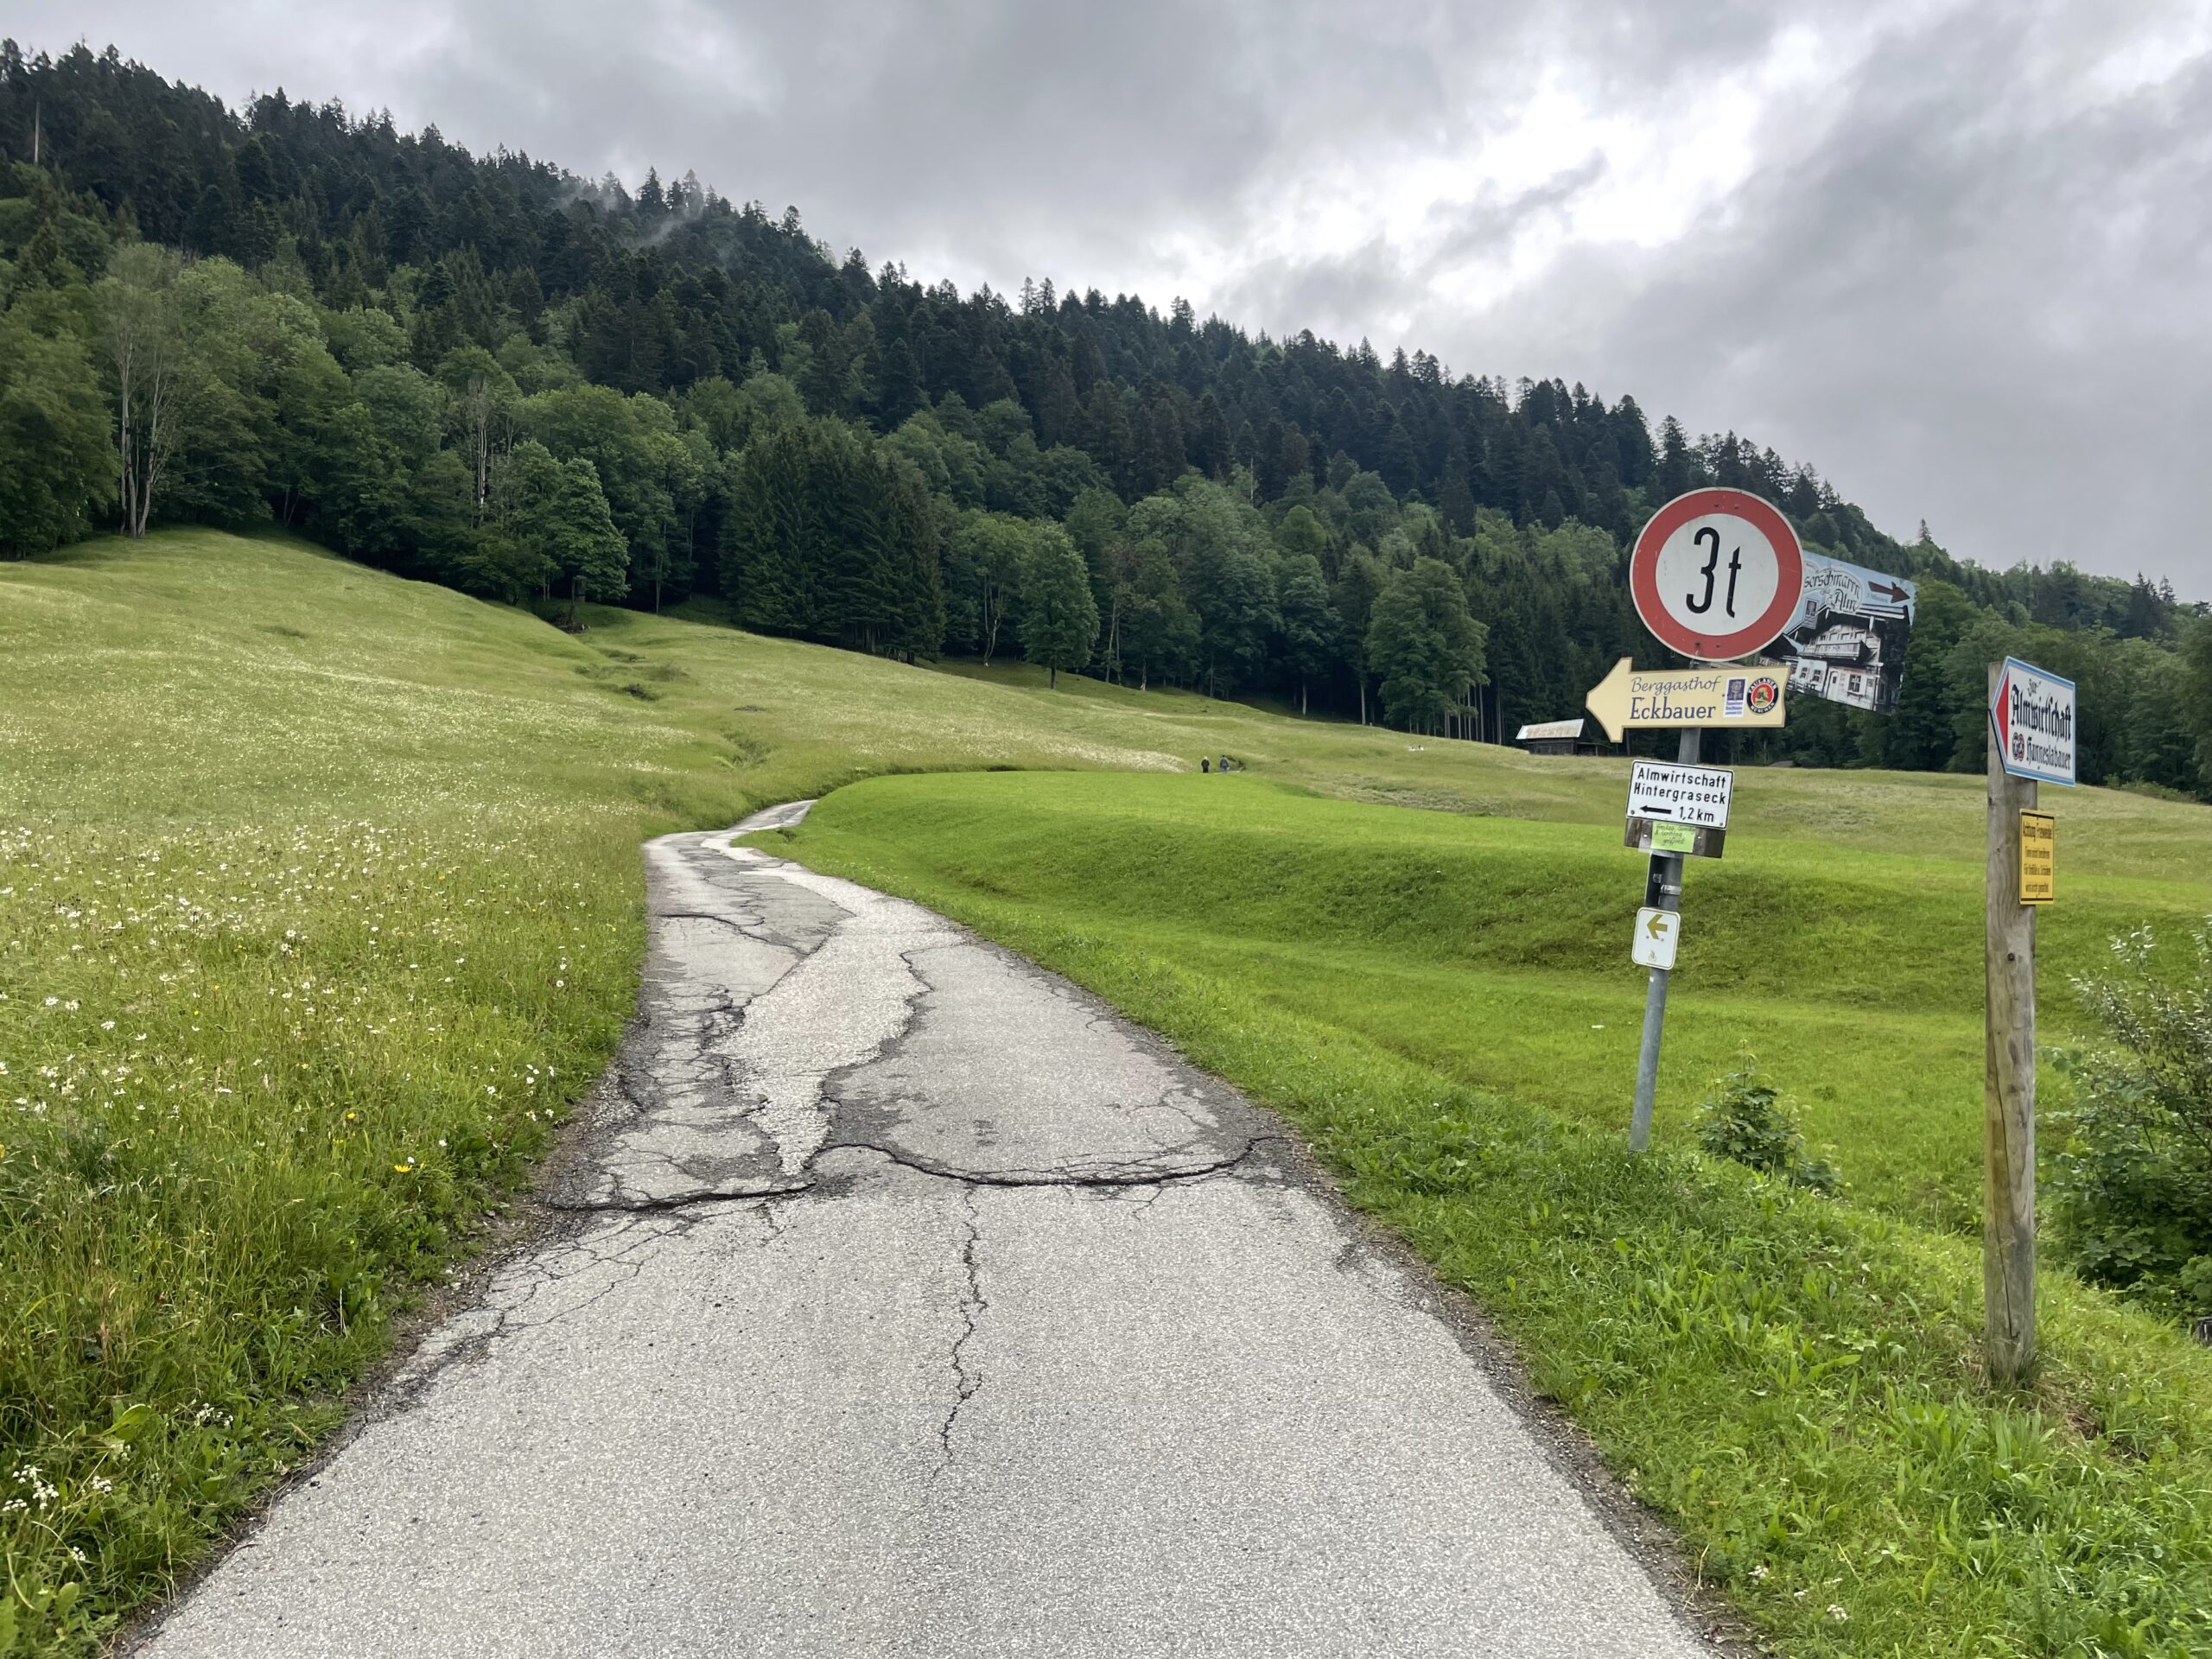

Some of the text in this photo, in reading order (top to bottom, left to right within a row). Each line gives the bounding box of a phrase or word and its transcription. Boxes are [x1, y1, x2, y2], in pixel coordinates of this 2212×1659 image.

[1831, 588, 1858, 612] Alm
[1631, 676, 1722, 695] Berggasthof
[1630, 696, 1717, 720] Eckbauer
[1637, 766, 1726, 789] Almwirtschaft
[1633, 782, 1726, 804] Hintergraseck
[1679, 806, 1714, 823] 1,2 km
